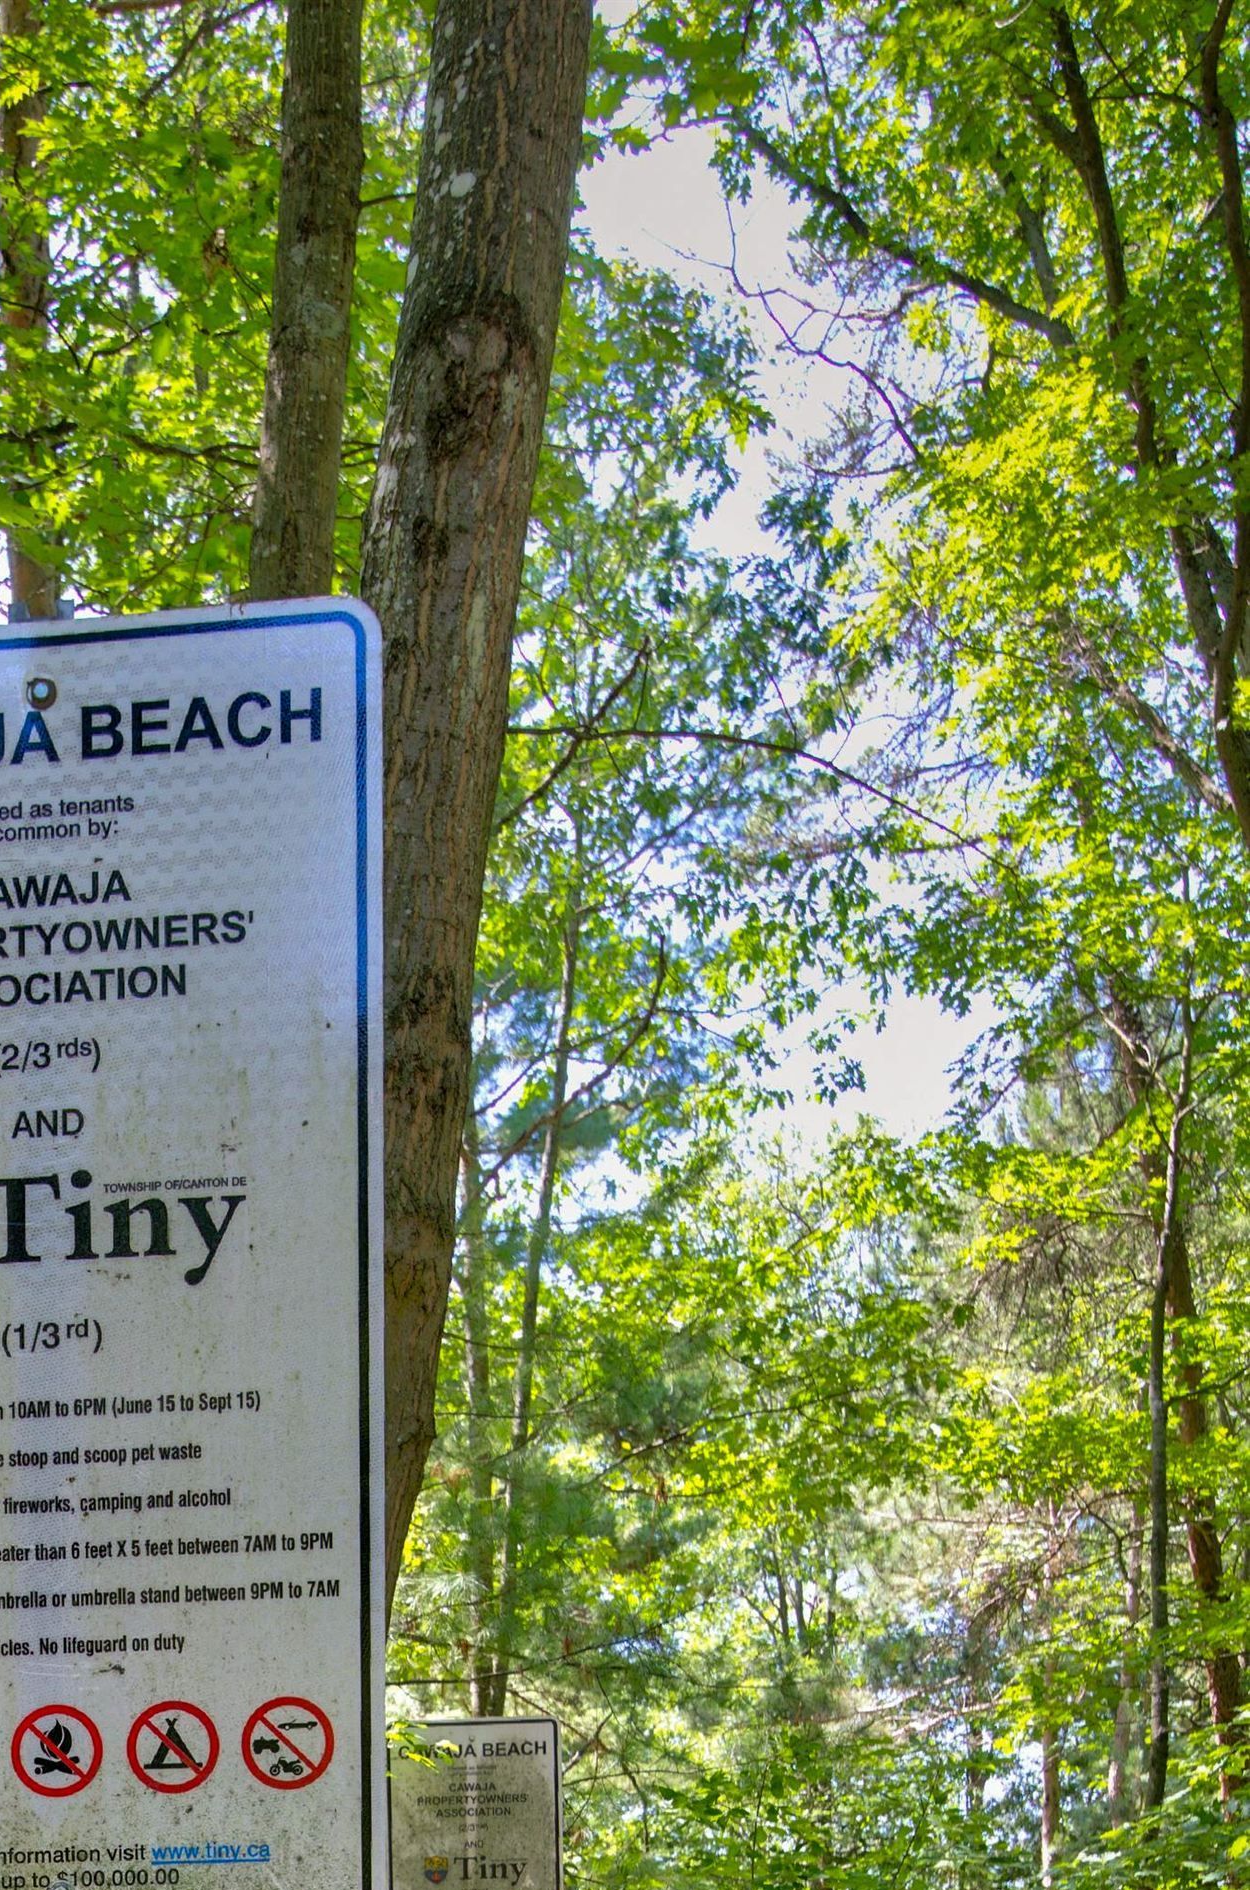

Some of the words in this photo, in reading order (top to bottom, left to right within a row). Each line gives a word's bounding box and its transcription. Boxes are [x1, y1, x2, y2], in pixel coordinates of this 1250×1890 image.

[81, 687, 322, 760] BEACH
[29, 802, 53, 819] as
[59, 795, 134, 817] tenants
[87, 819, 119, 841] by:
[11, 1109, 84, 1139] AND
[104, 1181, 161, 1193] TOWNSHIP
[165, 1177, 228, 1190] OF/CANTON
[232, 1177, 247, 1186] DE
[9, 1401, 50, 1419] 10AM
[55, 1401, 69, 1416] to
[73, 1398, 106, 1417] 6PM
[112, 1396, 152, 1418] (June
[158, 1395, 175, 1412] 15
[180, 1395, 194, 1411] to
[199, 1392, 232, 1413] Sept
[236, 1390, 261, 1412] 15)
[9, 1450, 48, 1469] stoop
[53, 1447, 79, 1465] and
[84, 1447, 127, 1466] scoop
[131, 1444, 155, 1465] pet
[159, 1443, 202, 1460] waste
[3, 1495, 75, 1515] fireworks,
[80, 1492, 142, 1514] camping
[147, 1491, 174, 1508] and
[178, 1488, 231, 1507] alcohol
[34, 1543, 66, 1560] than
[71, 1542, 80, 1559] 6
[85, 1540, 113, 1559] feet
[116, 1540, 127, 1557] X
[131, 1539, 141, 1556] 5
[145, 1538, 174, 1556] feet
[178, 1537, 239, 1555] between
[243, 1535, 277, 1552] 7AM
[282, 1534, 296, 1551] to
[300, 1532, 333, 1550] 9PM
[52, 1593, 66, 1607] or
[71, 1588, 136, 1607] umbrella
[141, 1586, 180, 1604] stand
[185, 1584, 246, 1602] between
[251, 1582, 283, 1599] 9PM
[288, 1581, 302, 1598] to
[307, 1580, 340, 1597] 7AM
[39, 1638, 58, 1655] No
[63, 1635, 127, 1656] lifeguard
[132, 1637, 149, 1651] on
[154, 1633, 185, 1653] duty
[482, 1740, 547, 1758] BEACH
[449, 1782, 496, 1793] CAWAJA
[435, 1806, 511, 1817] ASSOCIATION
[106, 1844, 146, 1861] visit
[151, 1842, 270, 1866] www.tiny.ca
[32, 1871, 50, 1889] to
[454, 1856, 528, 1886] Tiny
